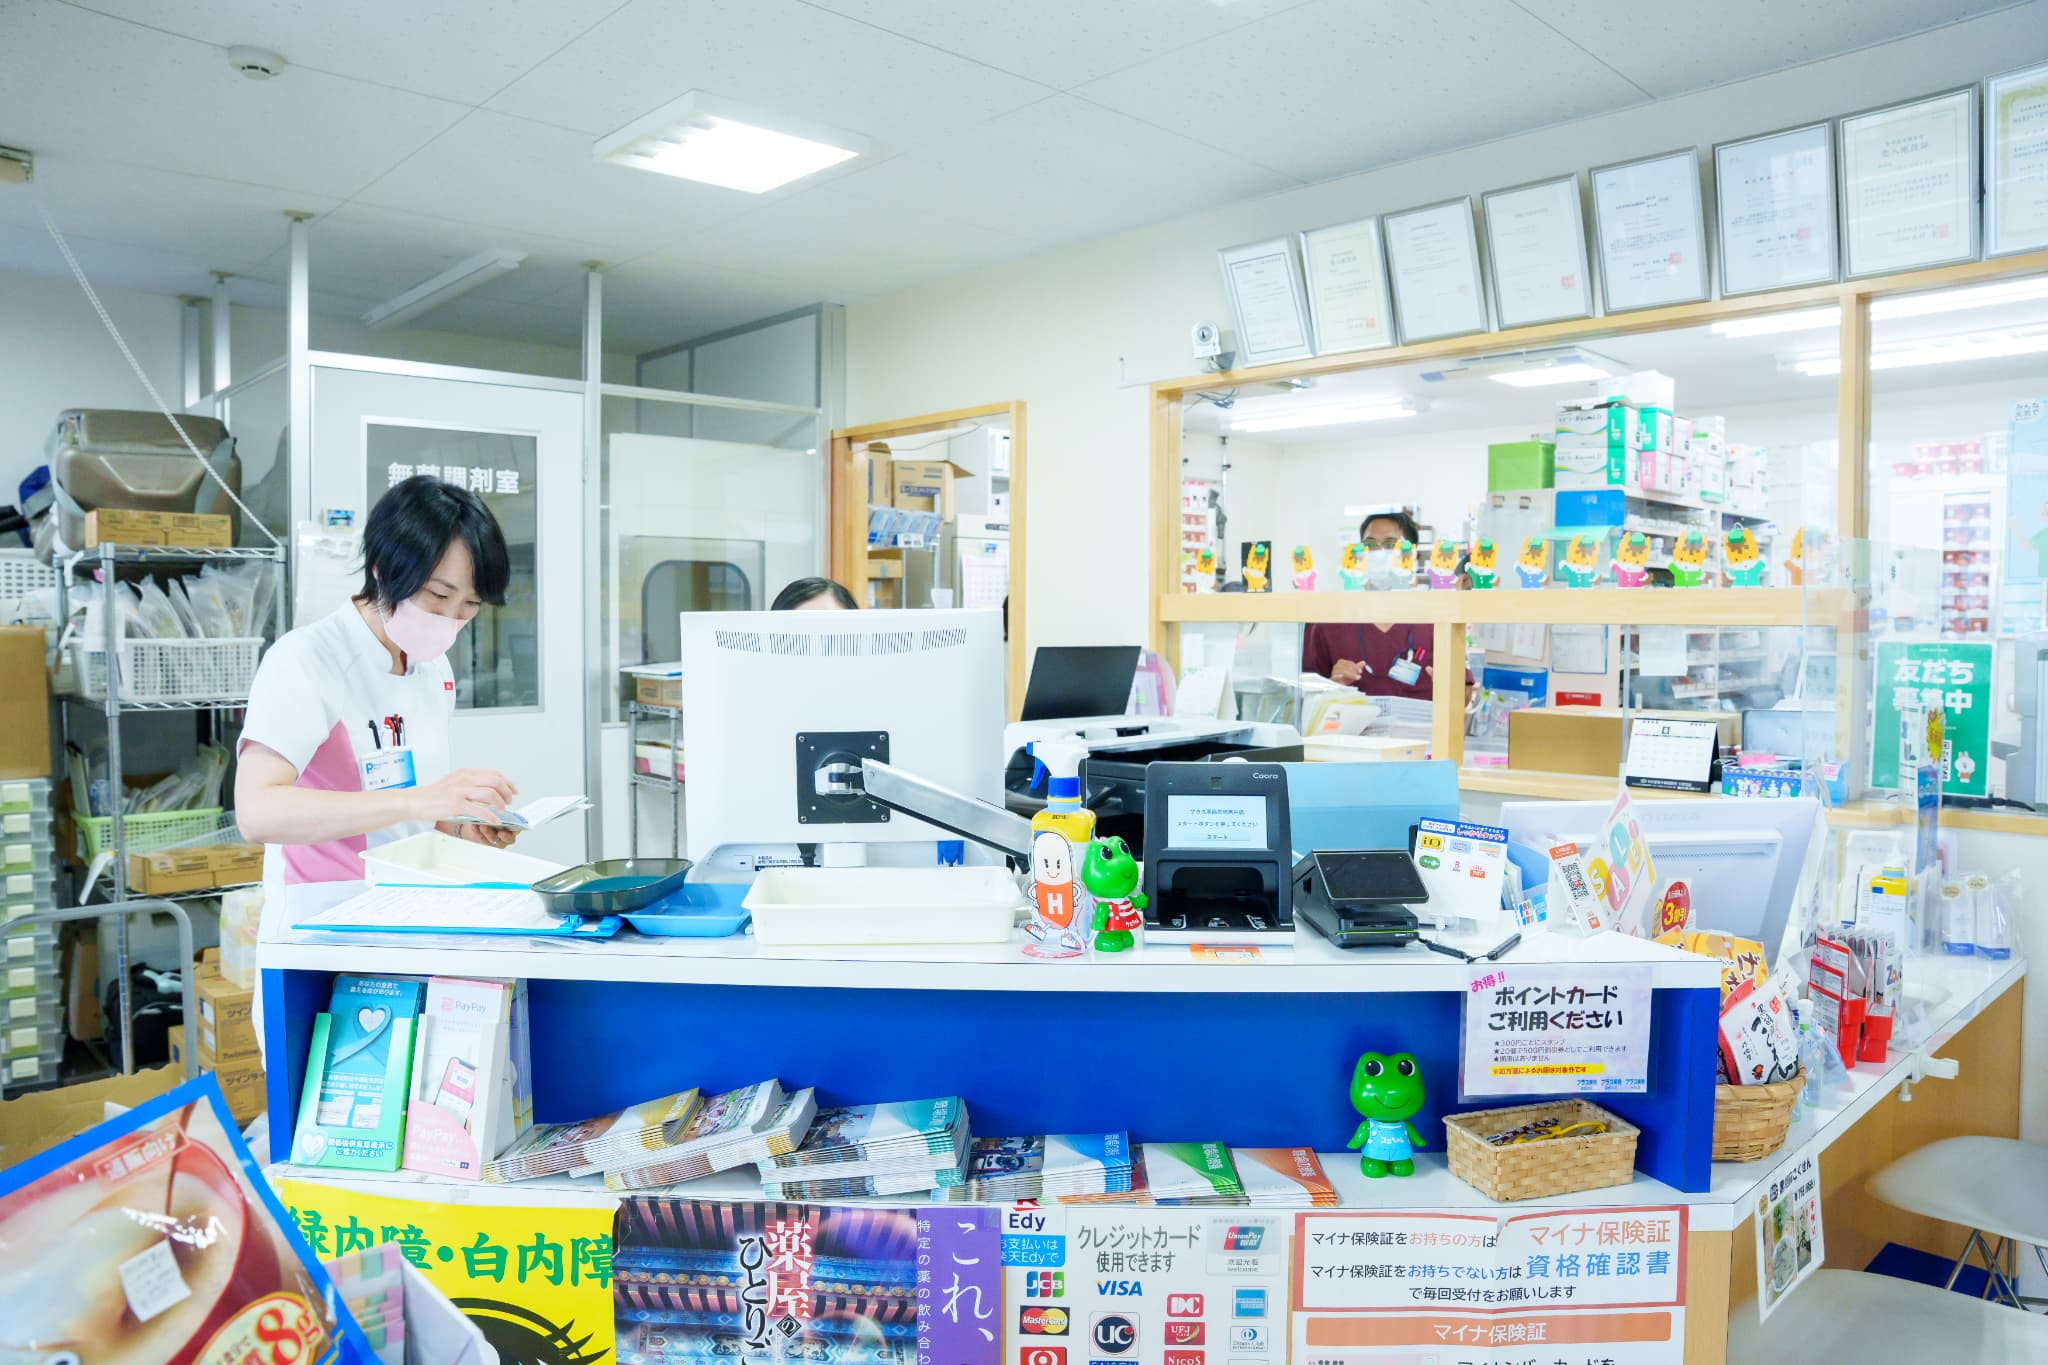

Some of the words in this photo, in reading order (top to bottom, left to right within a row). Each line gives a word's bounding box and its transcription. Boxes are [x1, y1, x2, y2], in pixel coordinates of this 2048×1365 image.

[1893, 658, 1975, 684] 友だち
[1047, 893, 1063, 915] H
[1495, 985, 1618, 1006] ポイントカード
[455, 1000, 487, 1013] PayPay
[1488, 1010, 1623, 1032] ご利用ください
[1009, 1212, 1046, 1232] Edy
[1529, 1219, 1671, 1246] マイナ保険証
[1078, 1225, 1201, 1249] クレジットカード
[1311, 1231, 1497, 1249] マイナ保険証をお持ちの方は
[1096, 1250, 1177, 1273] 使用できます
[1311, 1263, 1522, 1281] マイナ保険証をお持ちでない方は
[1526, 1251, 1671, 1280] 資格確認書
[1097, 1280, 1143, 1297] VISA
[1409, 1285, 1577, 1302] で毎回受付をお願いします
[1170, 1296, 1200, 1314] DC
[1171, 1325, 1190, 1334] UFJ
[1433, 1322, 1547, 1343] マイナ保険証
